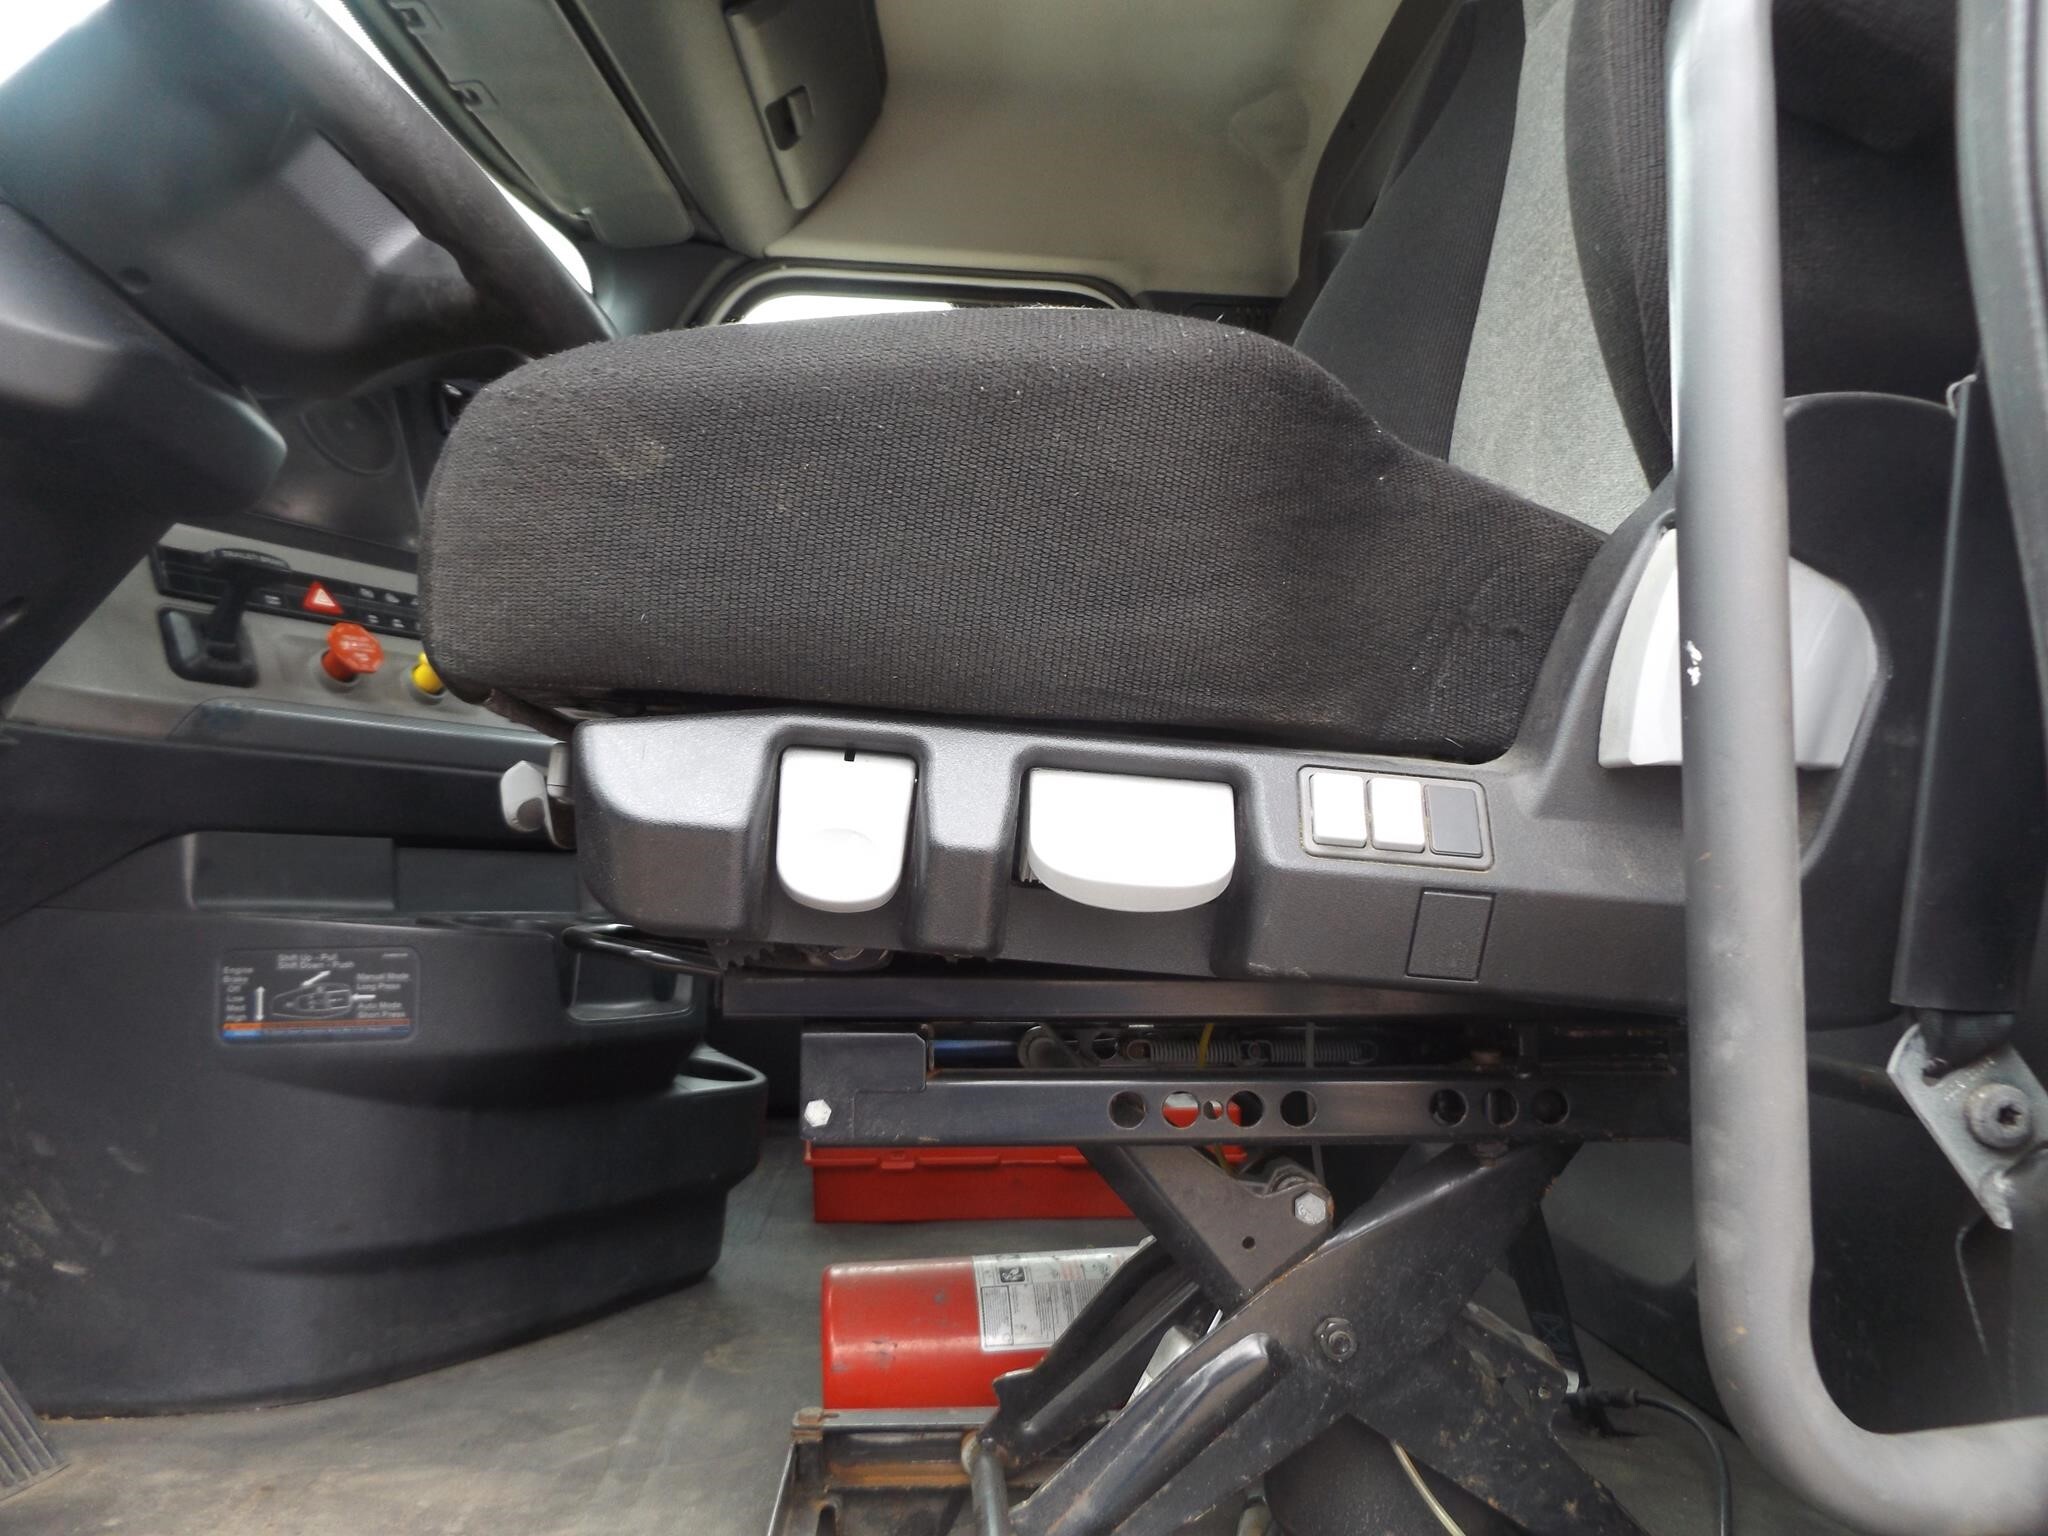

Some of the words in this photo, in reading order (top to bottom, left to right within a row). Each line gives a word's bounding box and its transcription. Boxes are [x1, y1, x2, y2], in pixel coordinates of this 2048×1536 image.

[300, 961, 324, 969] Down
[332, 961, 355, 969] Push
[223, 966, 254, 976] Engine
